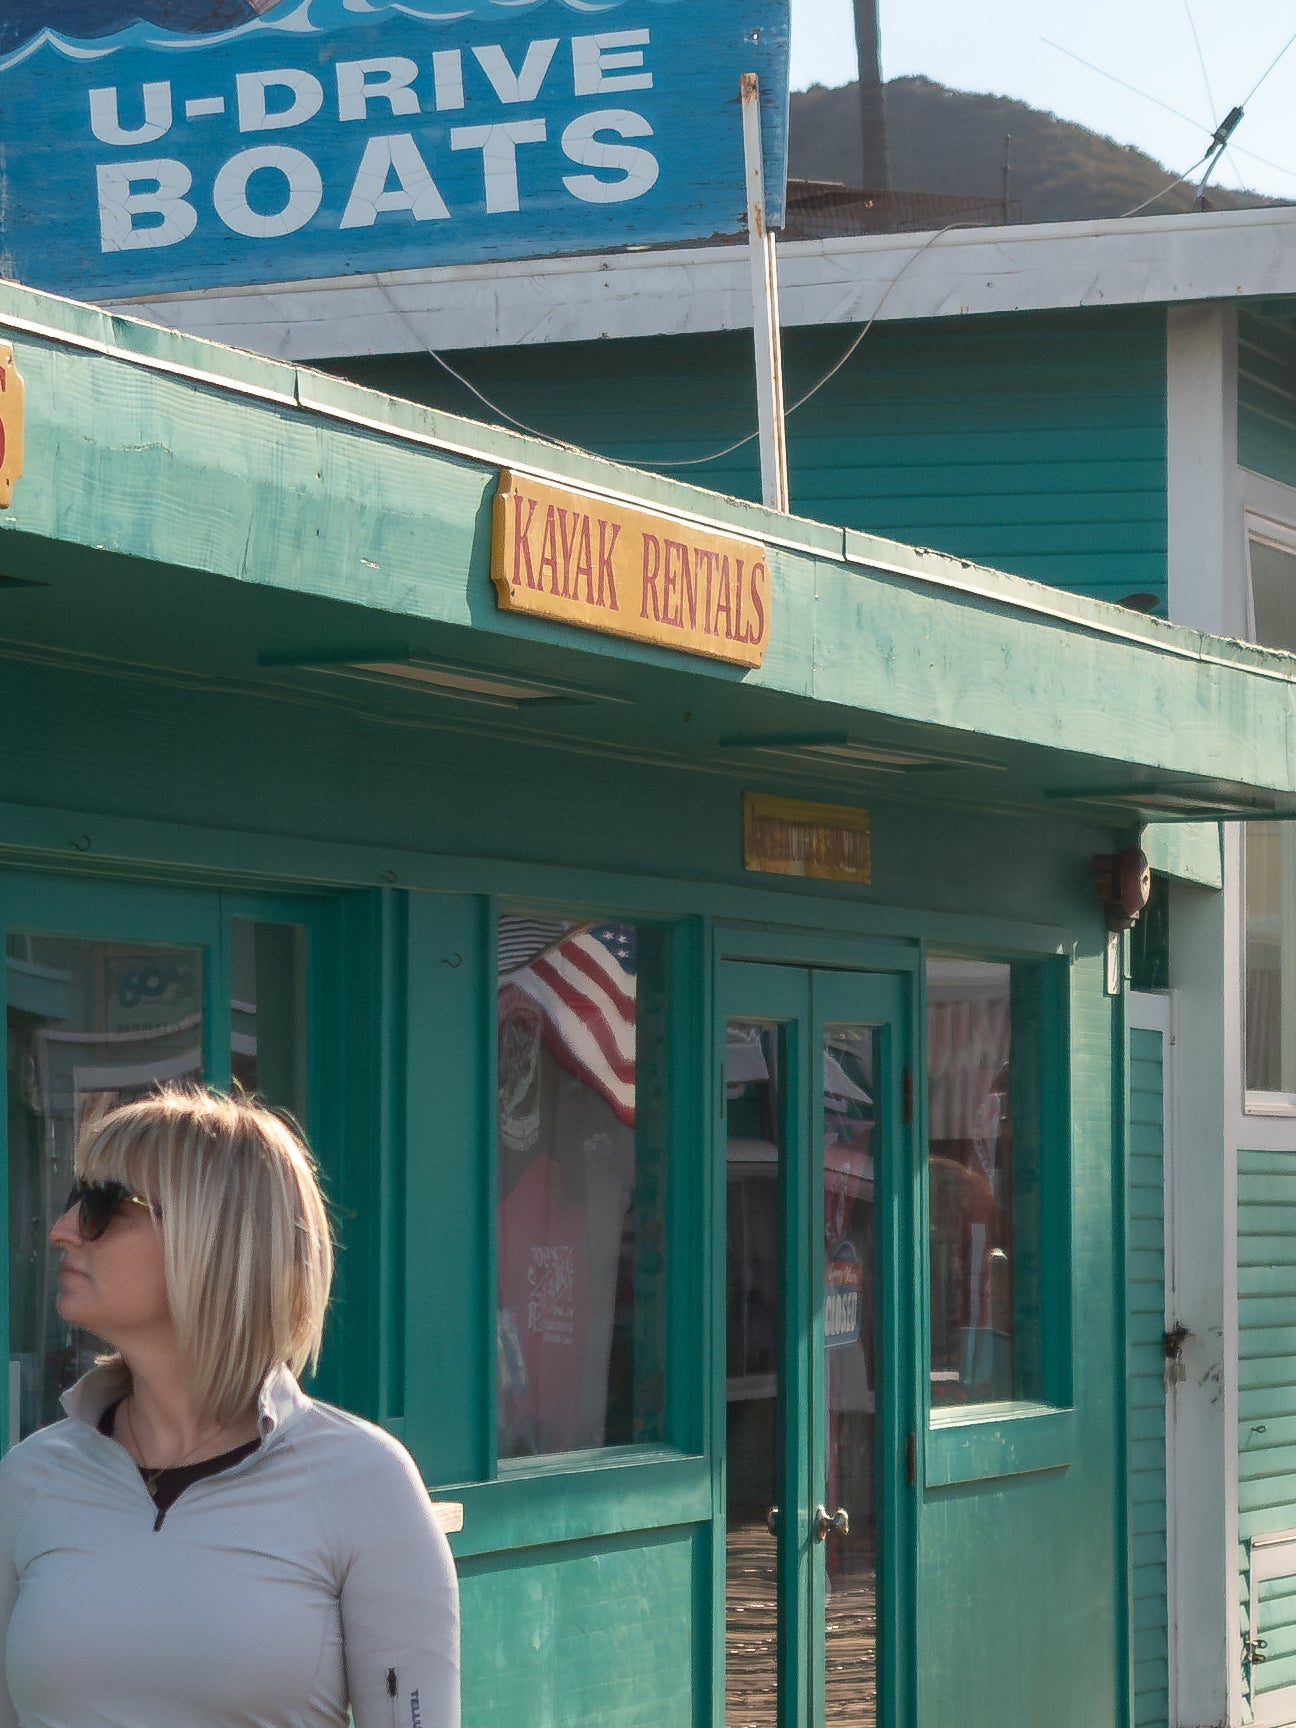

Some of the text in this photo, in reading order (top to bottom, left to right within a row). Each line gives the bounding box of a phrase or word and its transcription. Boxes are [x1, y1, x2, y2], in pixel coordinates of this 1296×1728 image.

[88, 27, 654, 147] U-DRIVE
[95, 108, 661, 253] BOATS
[511, 493, 766, 646] KAYAK RENTALS
